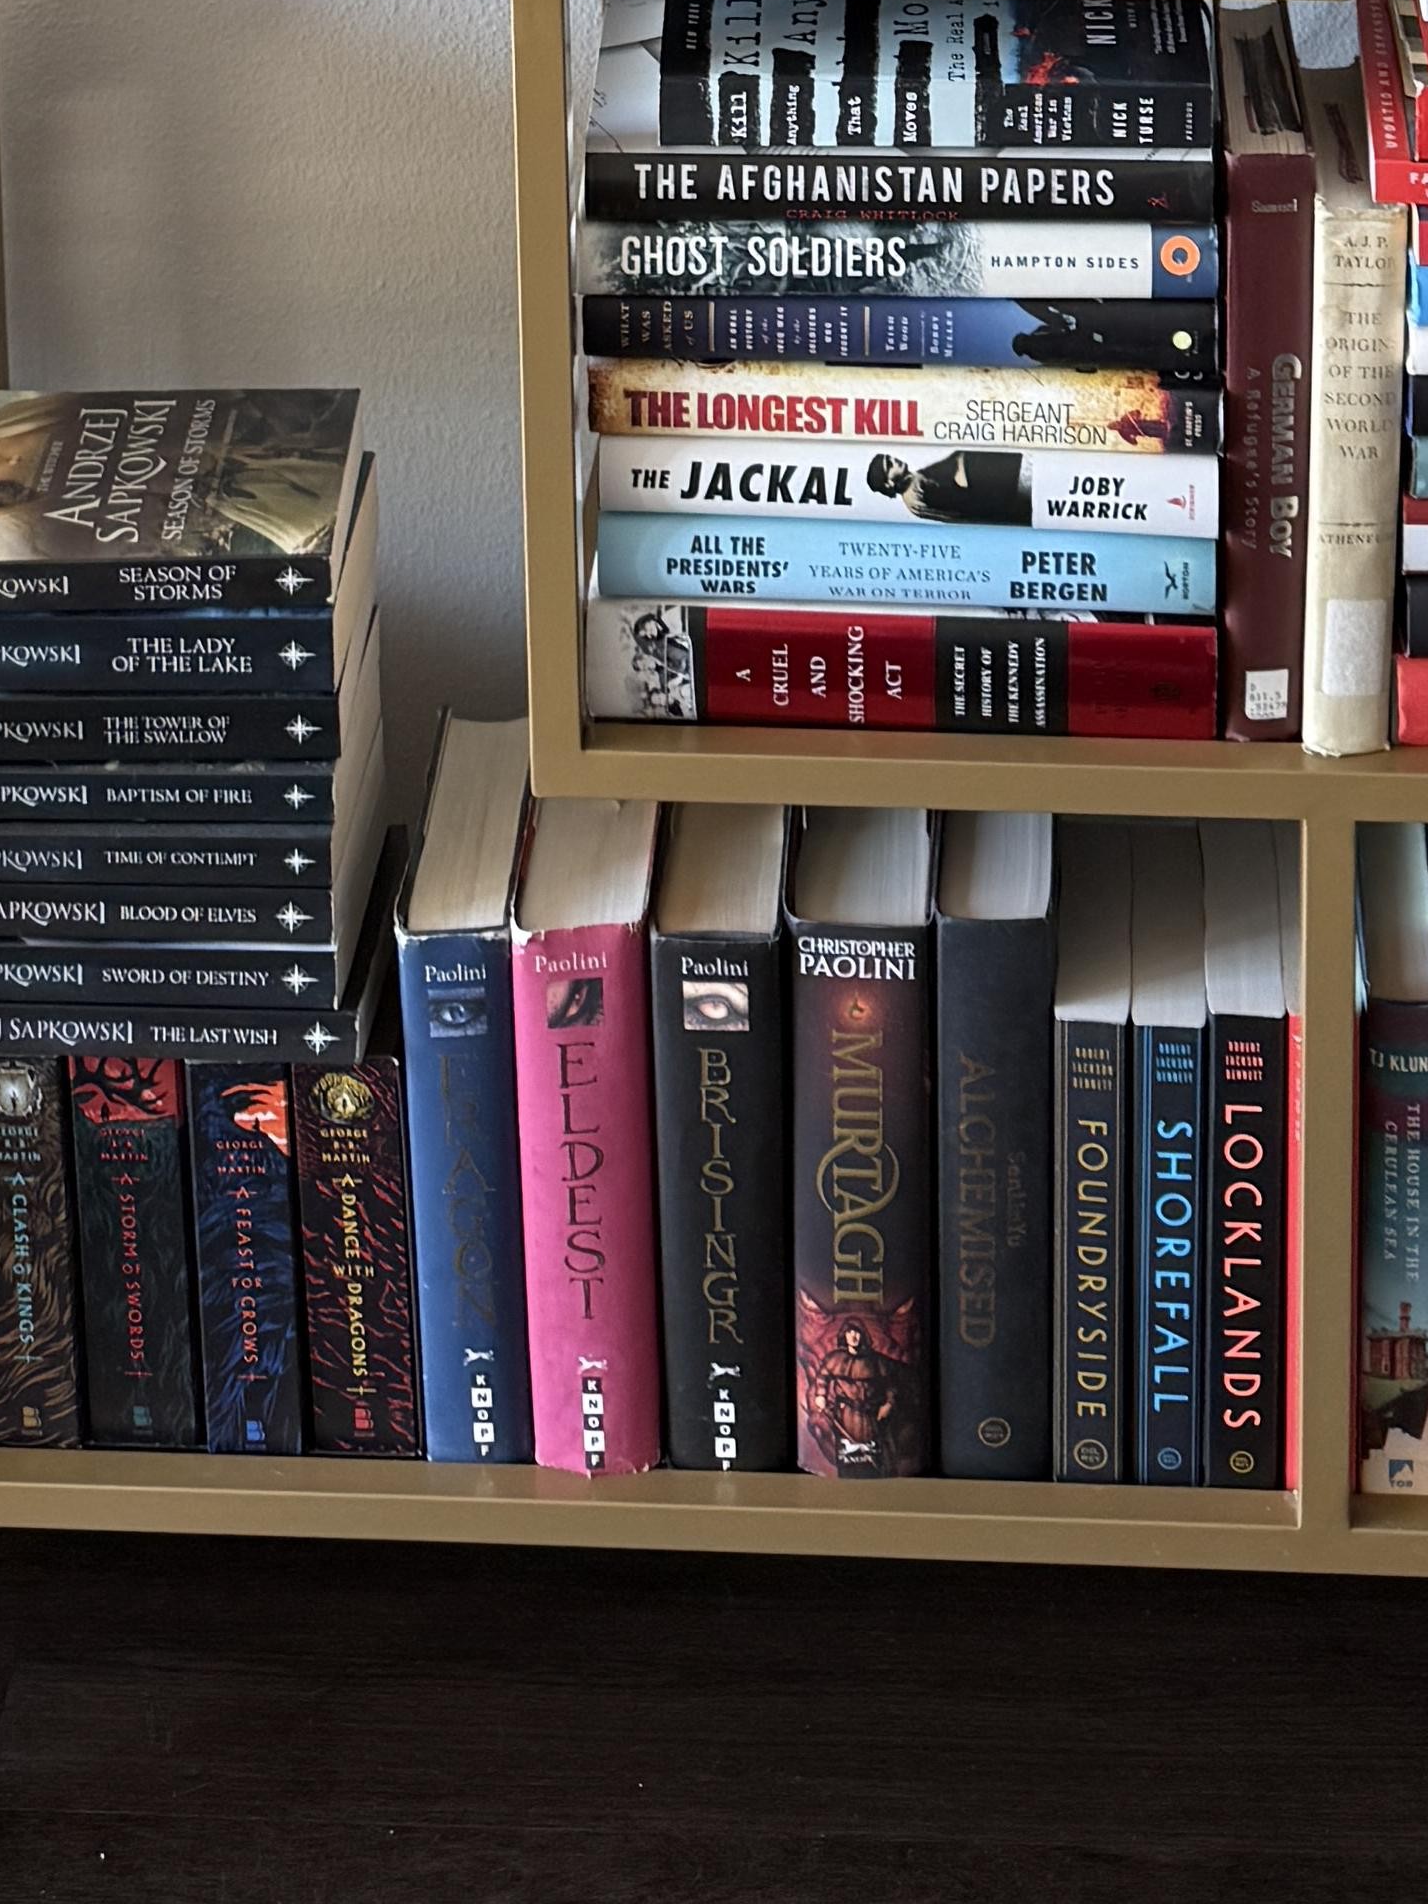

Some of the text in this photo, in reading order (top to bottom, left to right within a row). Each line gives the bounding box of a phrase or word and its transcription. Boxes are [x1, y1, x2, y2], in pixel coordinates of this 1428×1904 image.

[634, 164, 1114, 206] THE AFGHANISTAN PAPERS
[620, 236, 907, 277] GHOST SOLDIERS
[990, 255, 1140, 271] HAMPTON SIDES
[624, 389, 923, 436] THE LONGEST KILL
[631, 460, 854, 506] THE JACKAL
[1069, 476, 1125, 499] JOBY
[1047, 496, 1147, 521] WARRICK
[119, 566, 236, 584] SEASON OF
[134, 583, 223, 601] STORMS
[798, 937, 916, 958] CHRISTOPHER
[800, 956, 916, 980] PAOLINI
[558, 1042, 606, 1319] ELDEST
[816, 1029, 899, 1304] MURTAGH
[1076, 1120, 1109, 1418] FOUNDRYSIDE
[1153, 1120, 1193, 1412] SHOREFALL
[1223, 1105, 1262, 1428] LOCKLANDS
